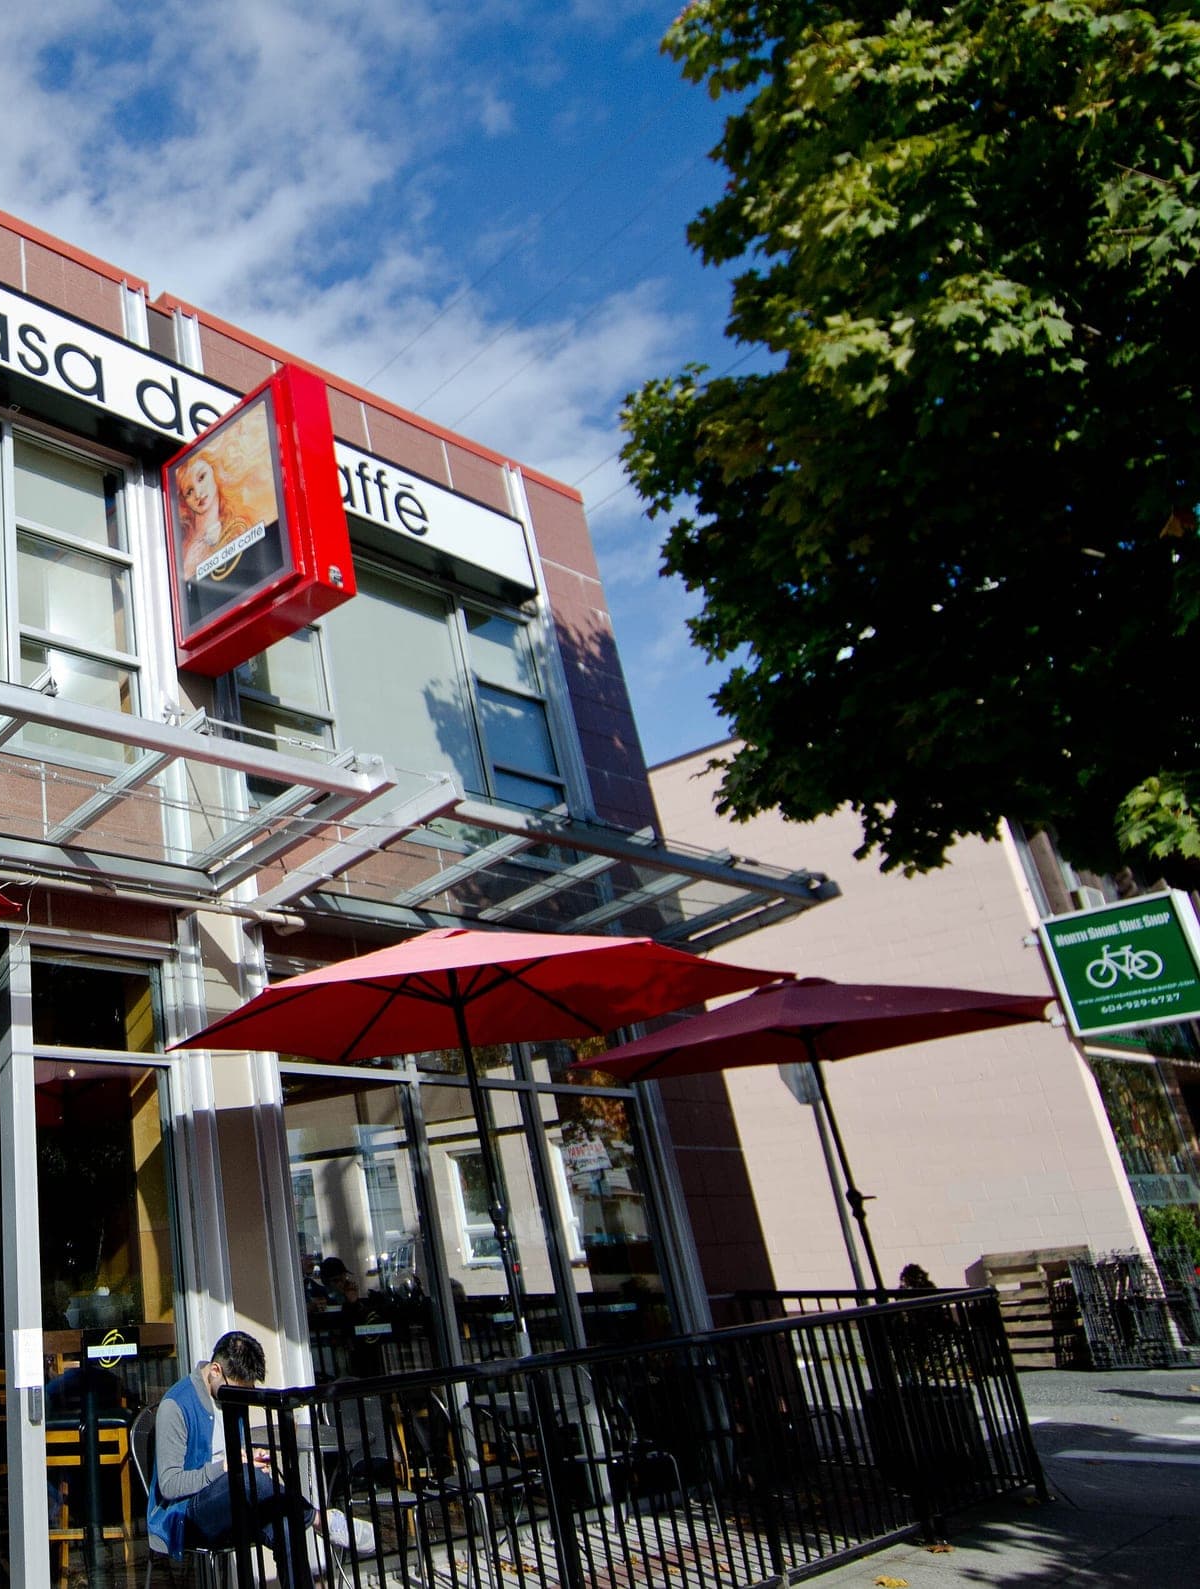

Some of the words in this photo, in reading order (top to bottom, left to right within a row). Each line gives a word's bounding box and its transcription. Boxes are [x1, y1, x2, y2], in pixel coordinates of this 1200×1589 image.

[135, 376, 224, 436] de
[197, 556, 220, 576] casa
[221, 543, 236, 560] del
[1055, 930, 1088, 947] NORTH
[1087, 923, 1120, 941] SHORE
[1118, 917, 1144, 934] BIKE
[1142, 912, 1171, 928] SHOP
[1101, 992, 1180, 1014] 604-929-6727
